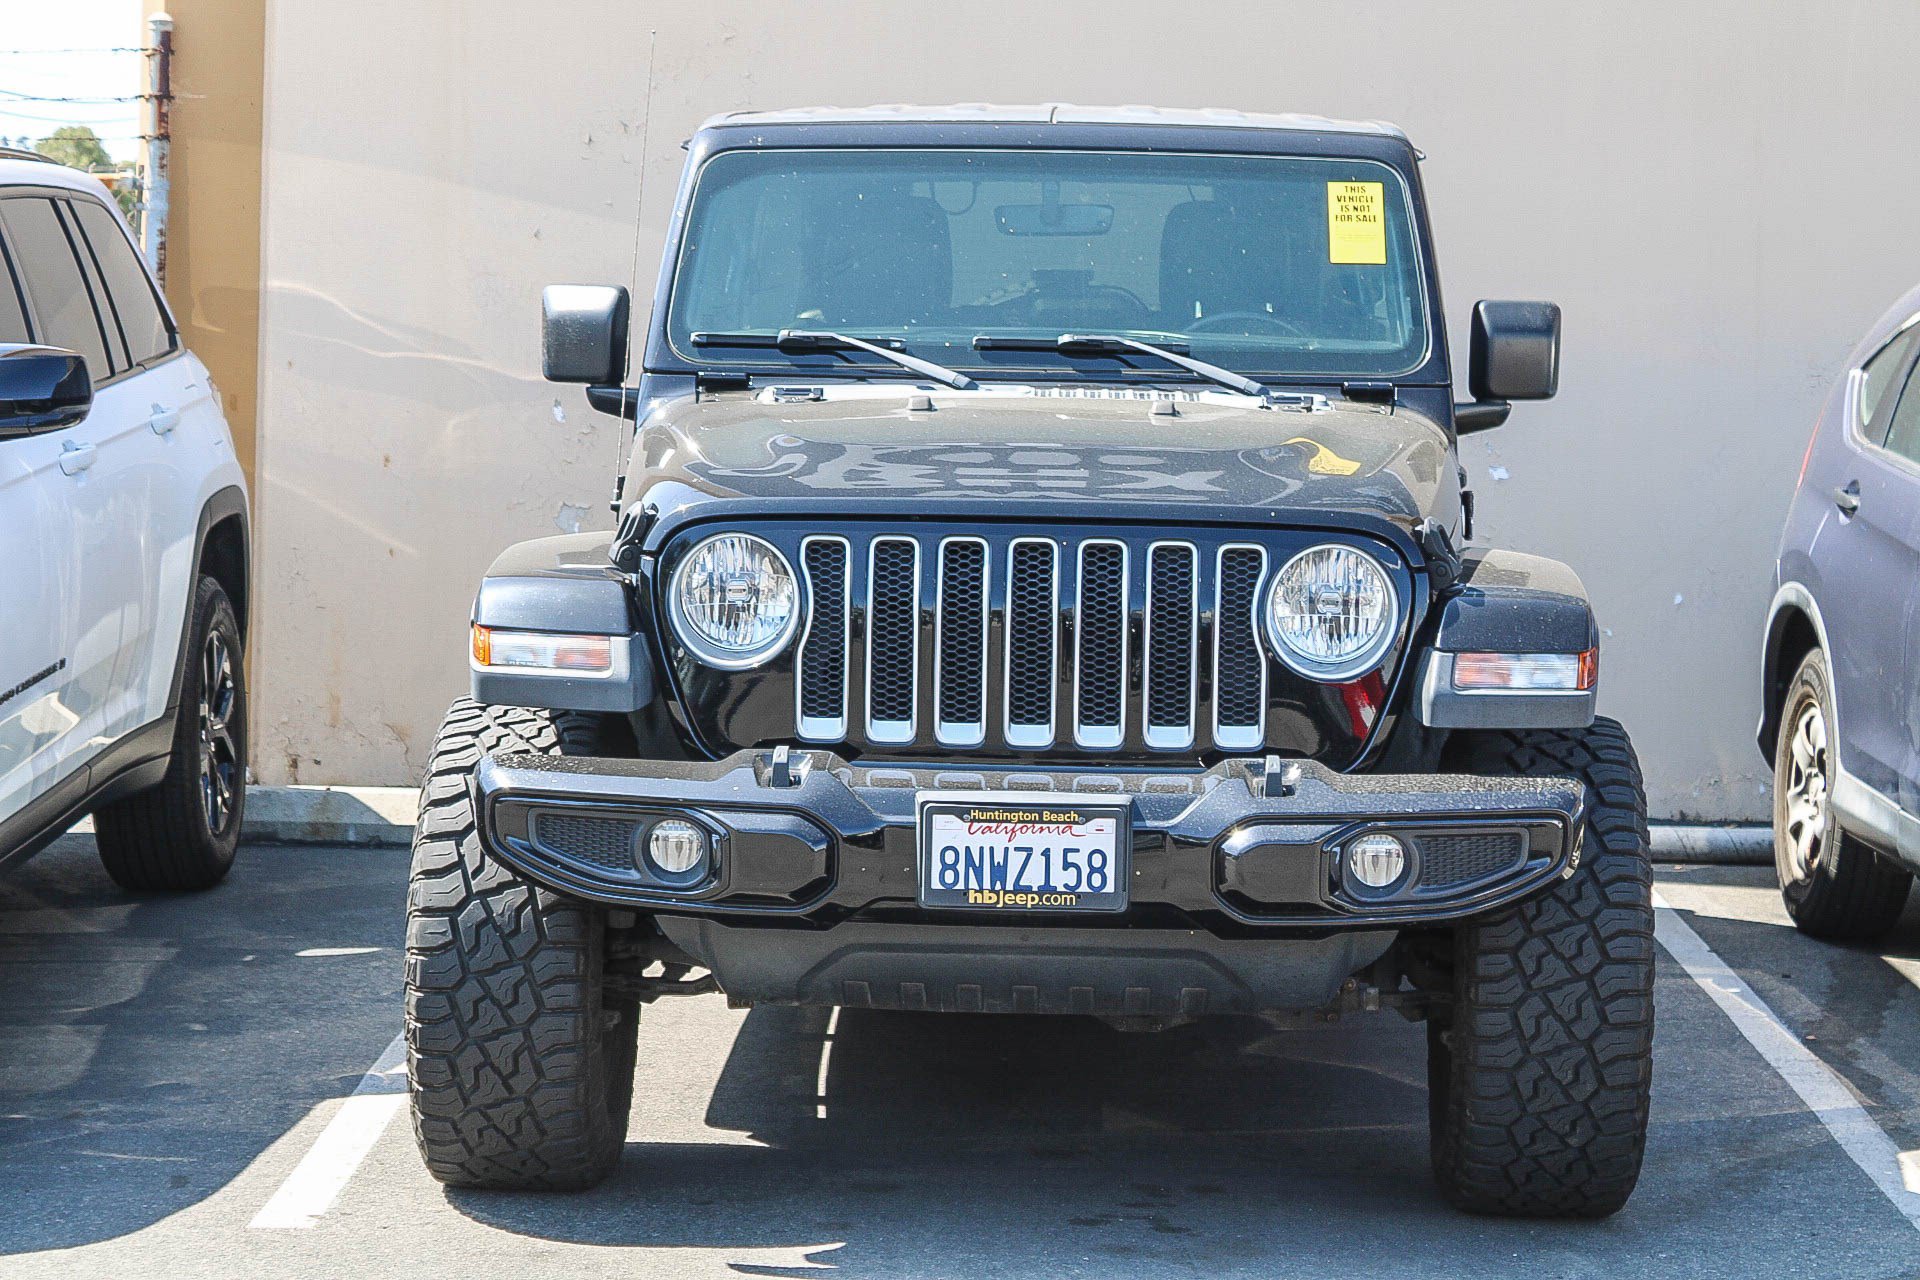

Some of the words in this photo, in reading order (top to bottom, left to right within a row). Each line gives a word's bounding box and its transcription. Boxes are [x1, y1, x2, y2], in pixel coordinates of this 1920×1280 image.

[1344, 185, 1367, 194] THIS
[1336, 195, 1374, 203] VEHICLE
[1340, 204, 1350, 213] IS
[1353, 204, 1371, 213] NOT
[1335, 214, 1353, 223] FOR
[1355, 214, 1377, 223] SALE
[970, 809, 1039, 823] Huntington
[1043, 810, 1079, 822] Beach
[938, 845, 1108, 893] 8NWZ158
